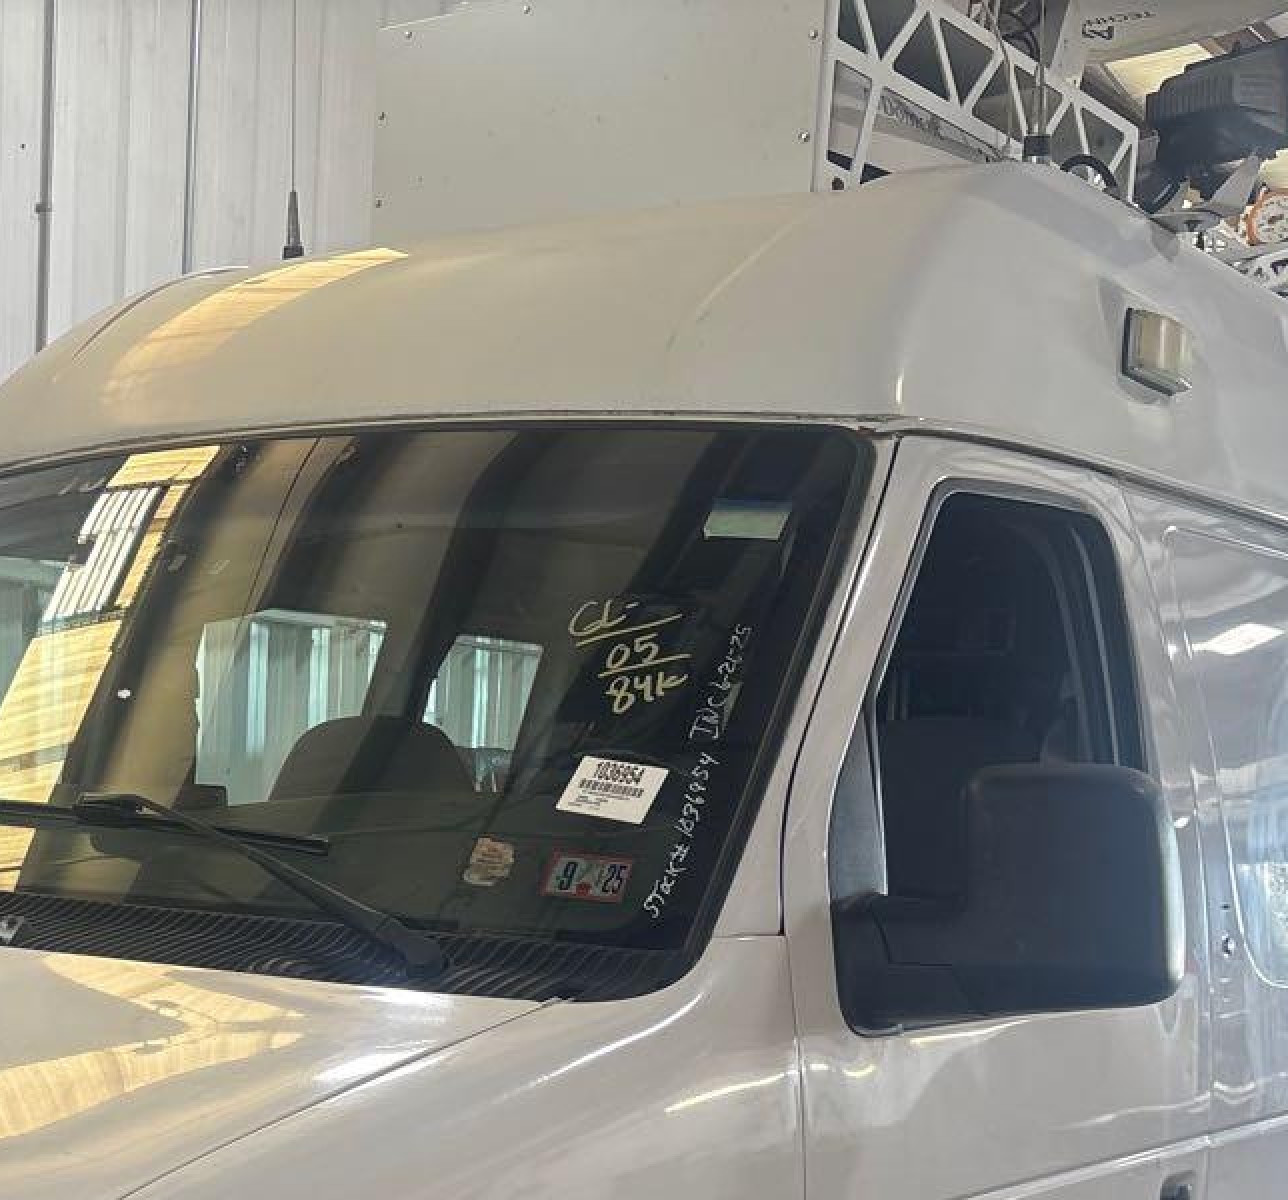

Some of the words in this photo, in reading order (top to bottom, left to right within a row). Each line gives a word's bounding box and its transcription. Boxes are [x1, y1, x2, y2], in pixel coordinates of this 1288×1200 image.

[605, 633, 659, 671] 05
[593, 761, 646, 785] 1036954
[674, 751, 720, 838] 1036954
[558, 861, 578, 891] 9
[601, 864, 628, 893] 25
